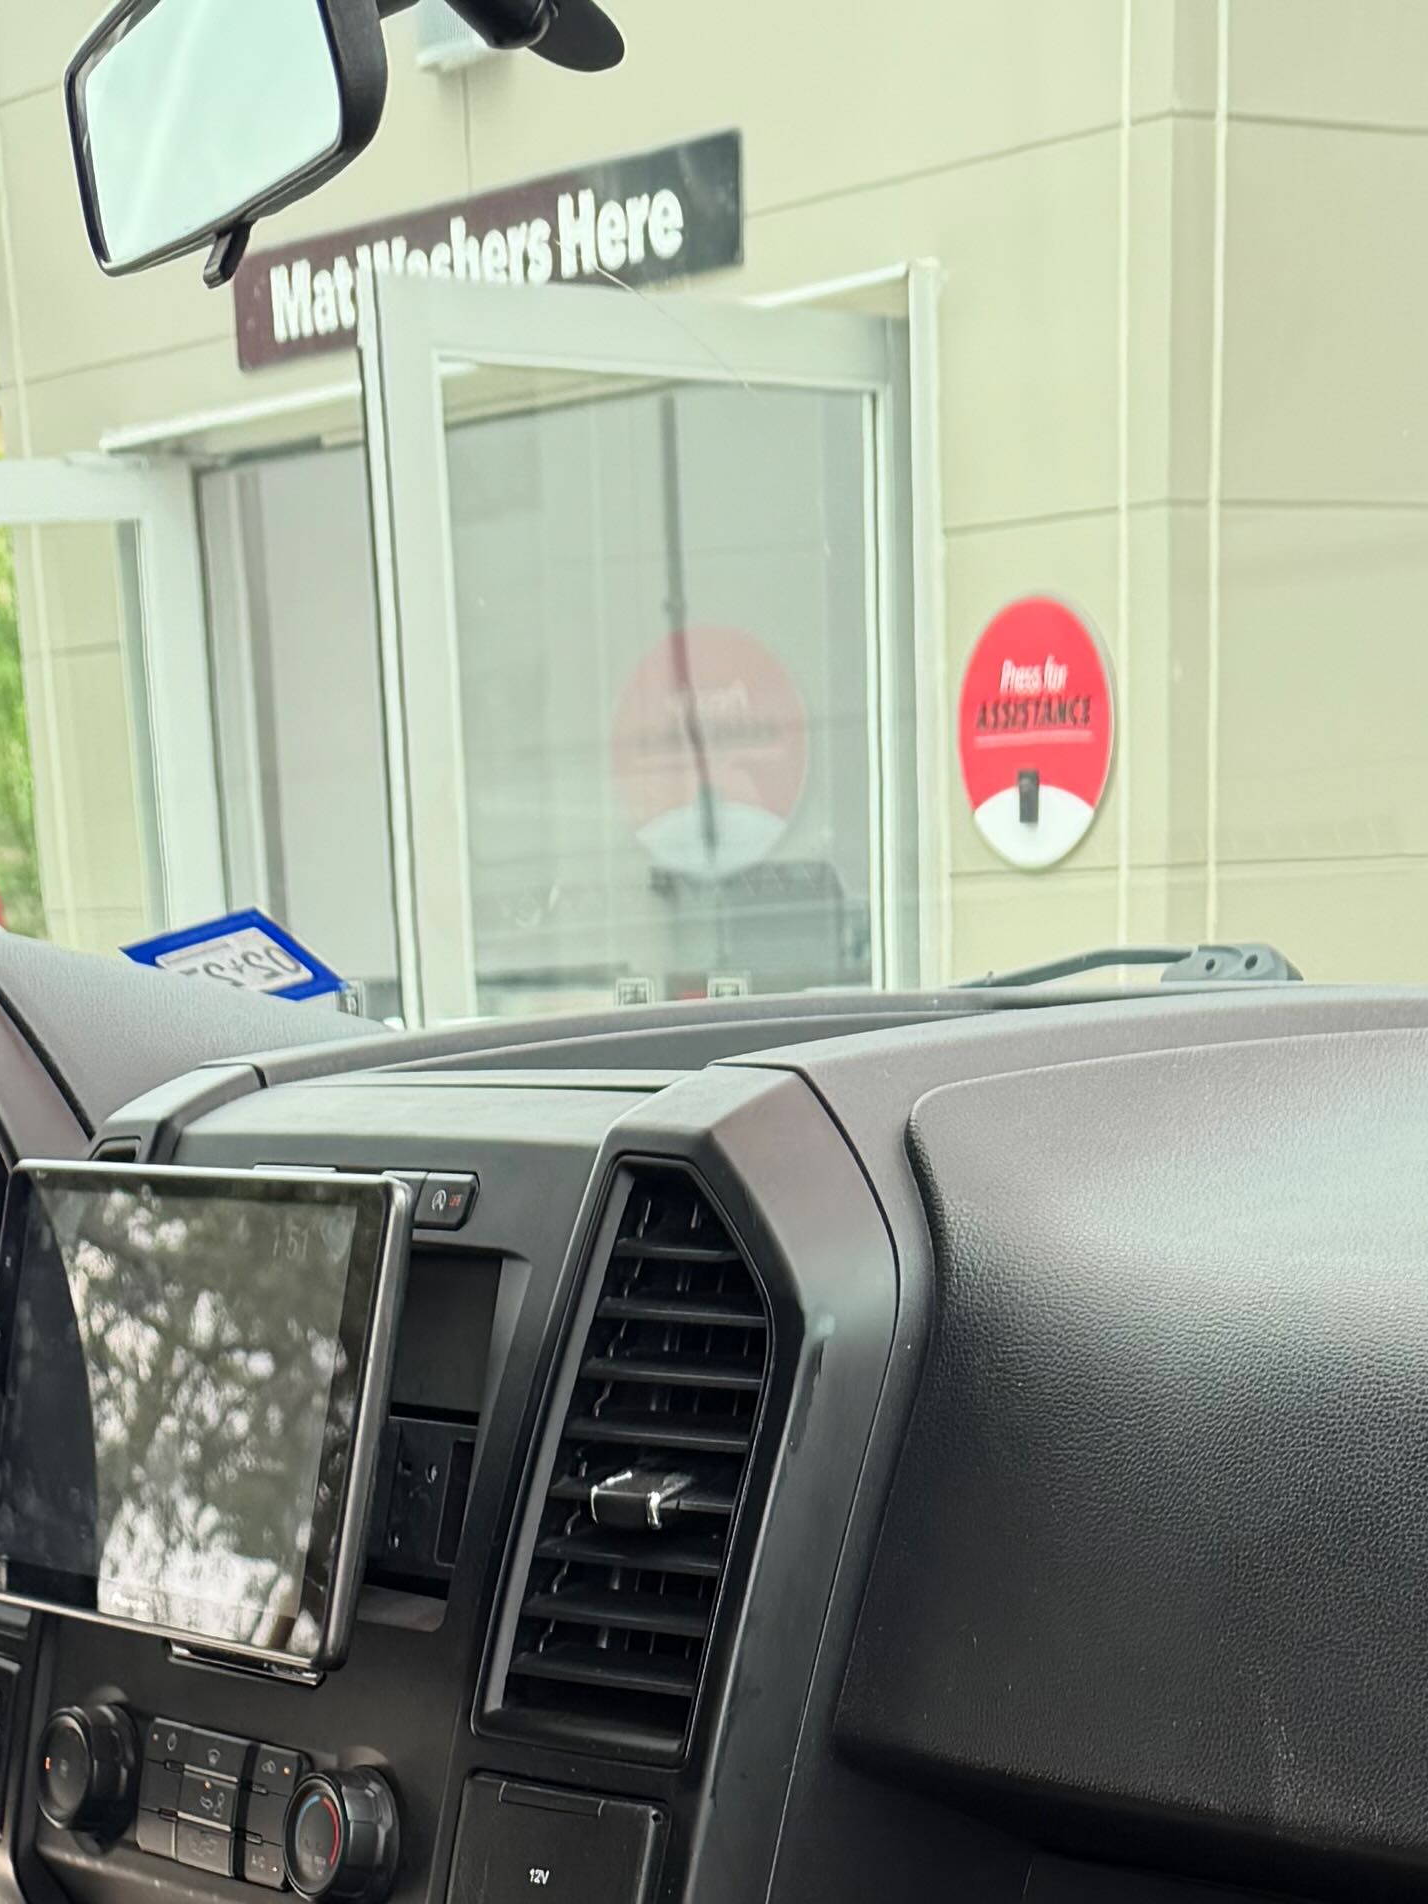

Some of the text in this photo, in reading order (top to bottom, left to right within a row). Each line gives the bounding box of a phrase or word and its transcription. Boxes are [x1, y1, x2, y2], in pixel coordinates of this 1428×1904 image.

[270, 256, 356, 344] Mat
[556, 187, 685, 278] Here
[1000, 655, 1069, 695] Press for
[976, 695, 1092, 732] ASSISTANCE
[529, 1868, 550, 1885] 12V
